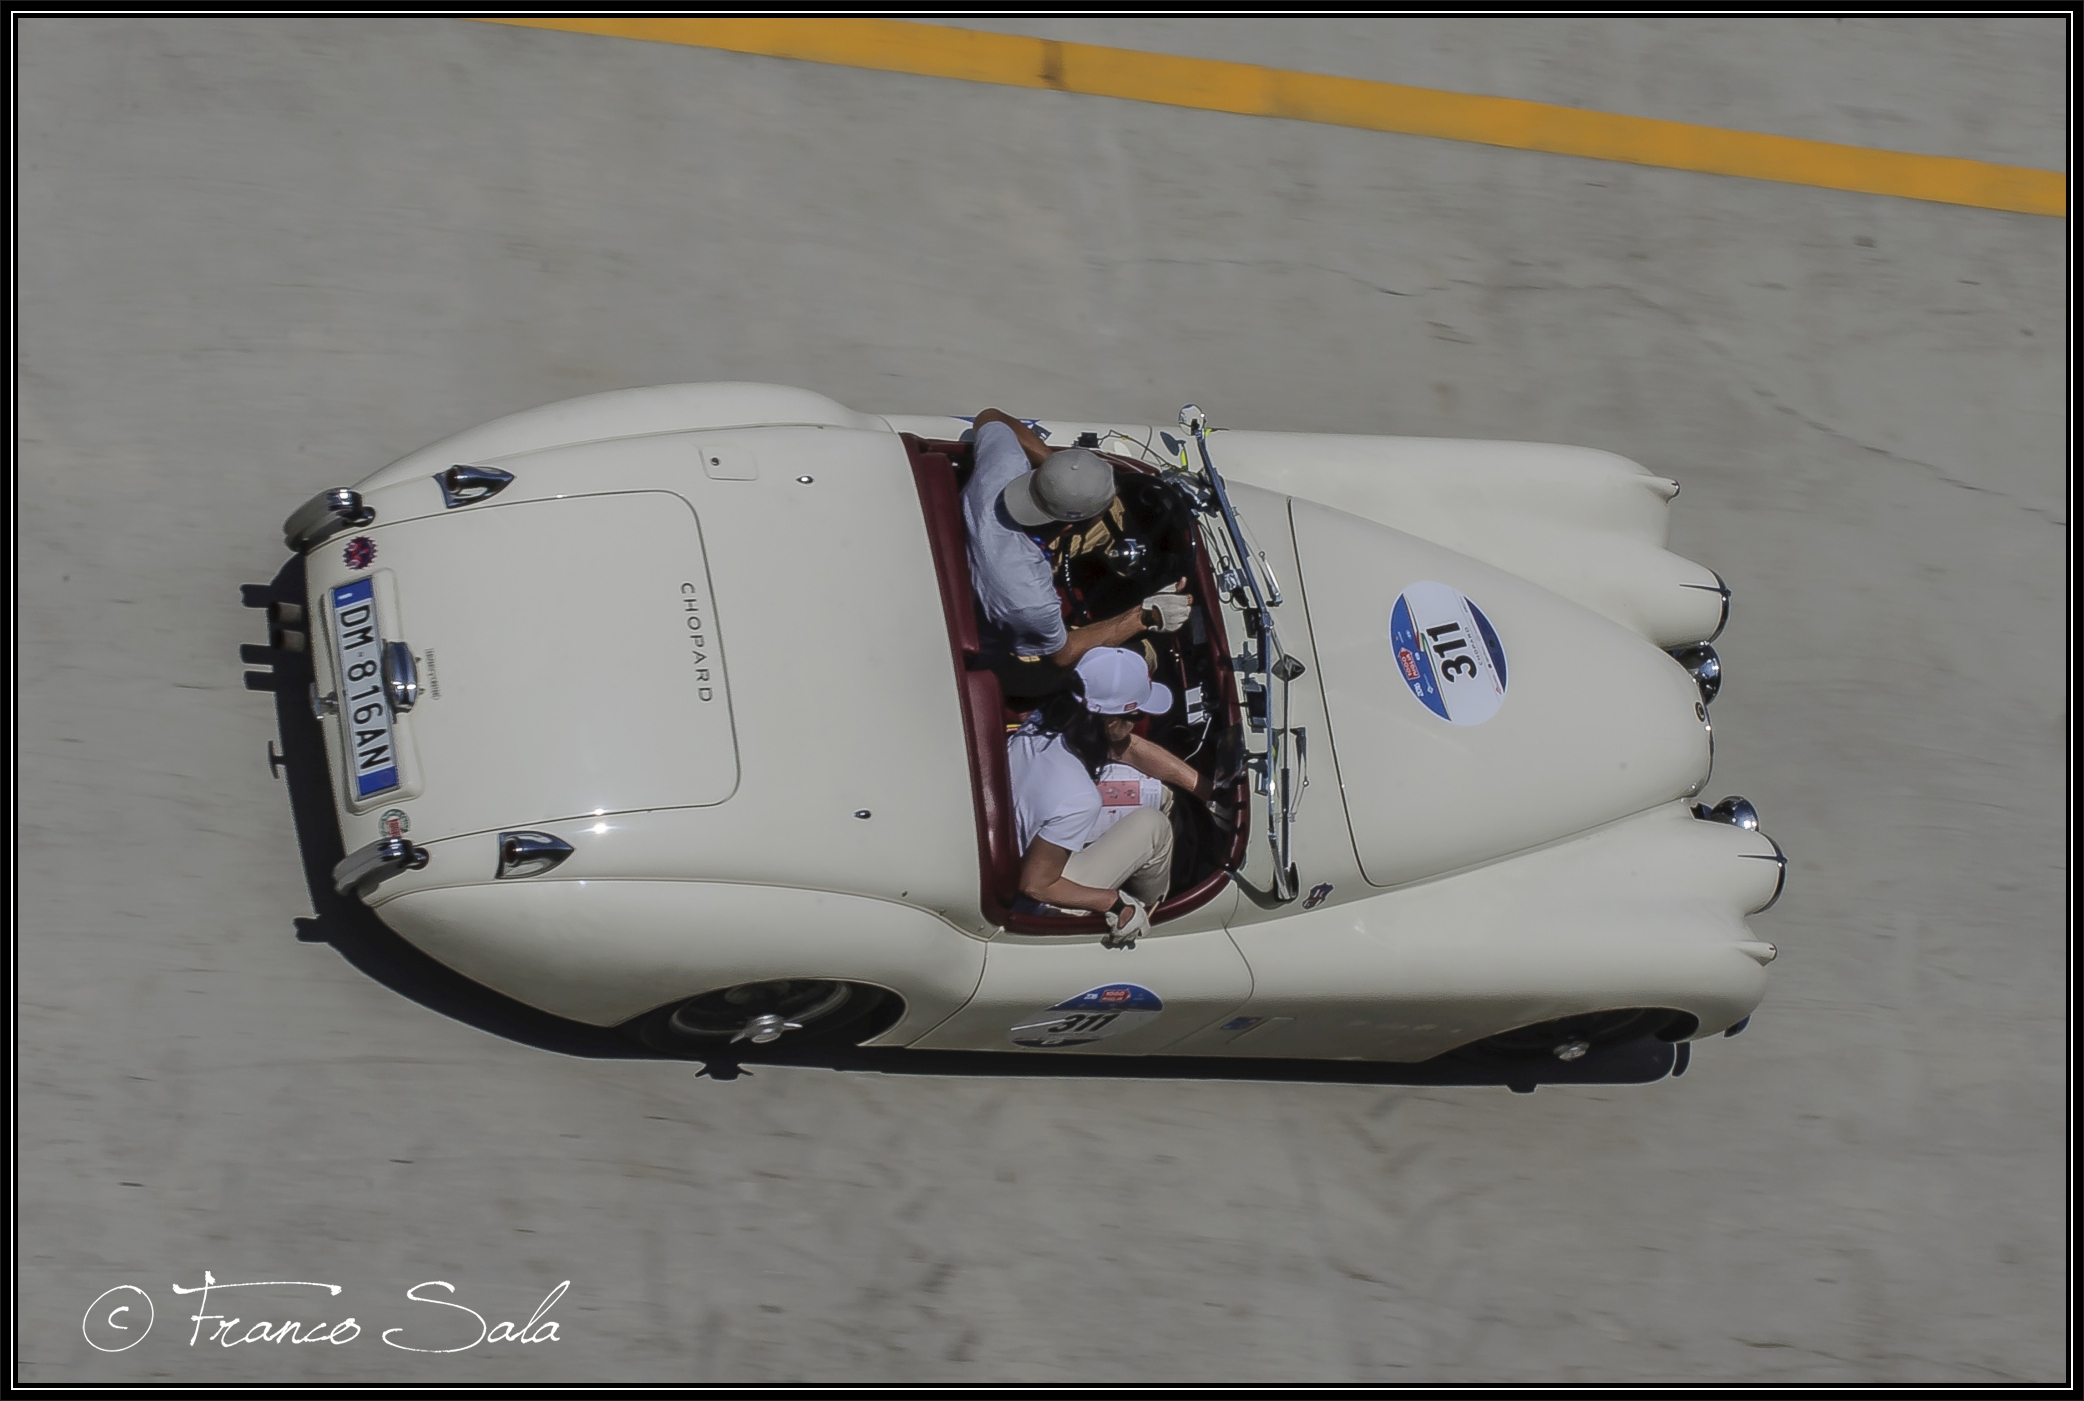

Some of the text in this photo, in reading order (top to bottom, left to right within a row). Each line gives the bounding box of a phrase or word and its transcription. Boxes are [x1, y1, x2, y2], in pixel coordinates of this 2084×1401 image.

[339, 604, 375, 650] DM
[681, 582, 713, 702] CHOPARD
[1464, 627, 1484, 667] CHOPARD
[1401, 656, 1413, 677] 1000
[1426, 622, 1477, 683] 311
[347, 659, 391, 770] 816AN
[1048, 1013, 1120, 1033] 311
